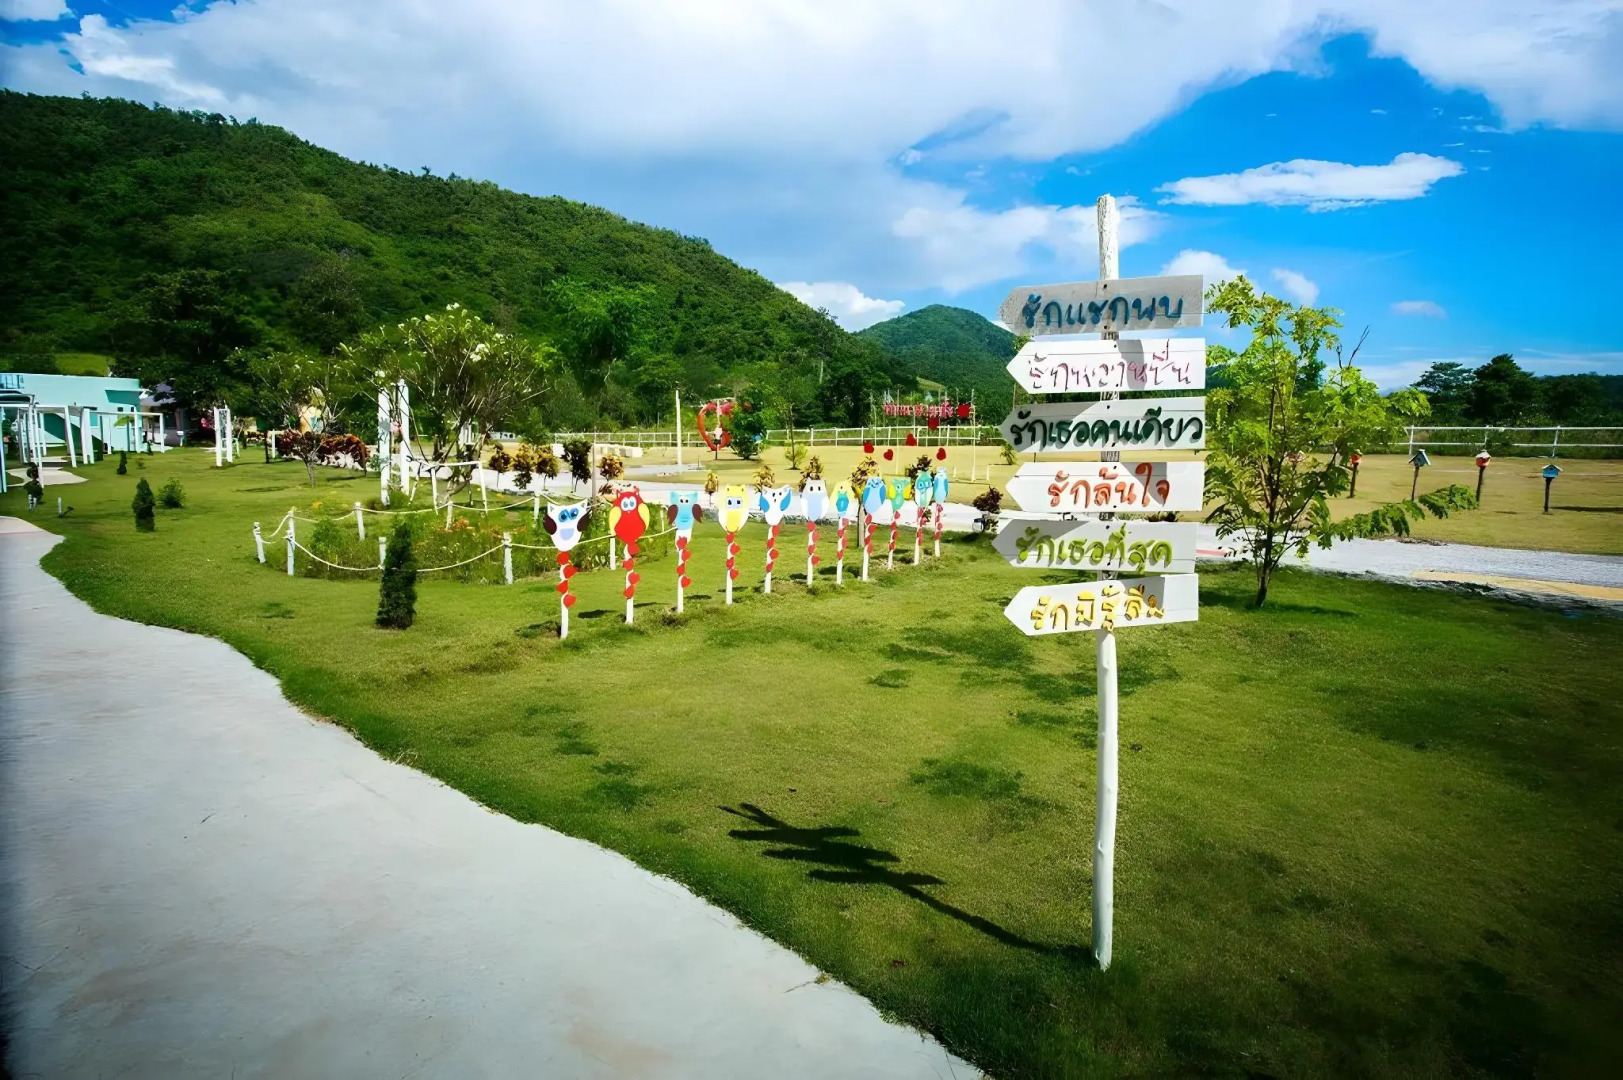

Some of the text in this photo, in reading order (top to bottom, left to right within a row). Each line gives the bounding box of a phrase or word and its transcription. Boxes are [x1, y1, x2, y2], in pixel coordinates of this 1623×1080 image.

[1010, 406, 1204, 448] รักเธอคนเดียว
[1047, 461, 1171, 508] รักล้นใจ
[1015, 522, 1173, 575] รักเธอที่สุด
